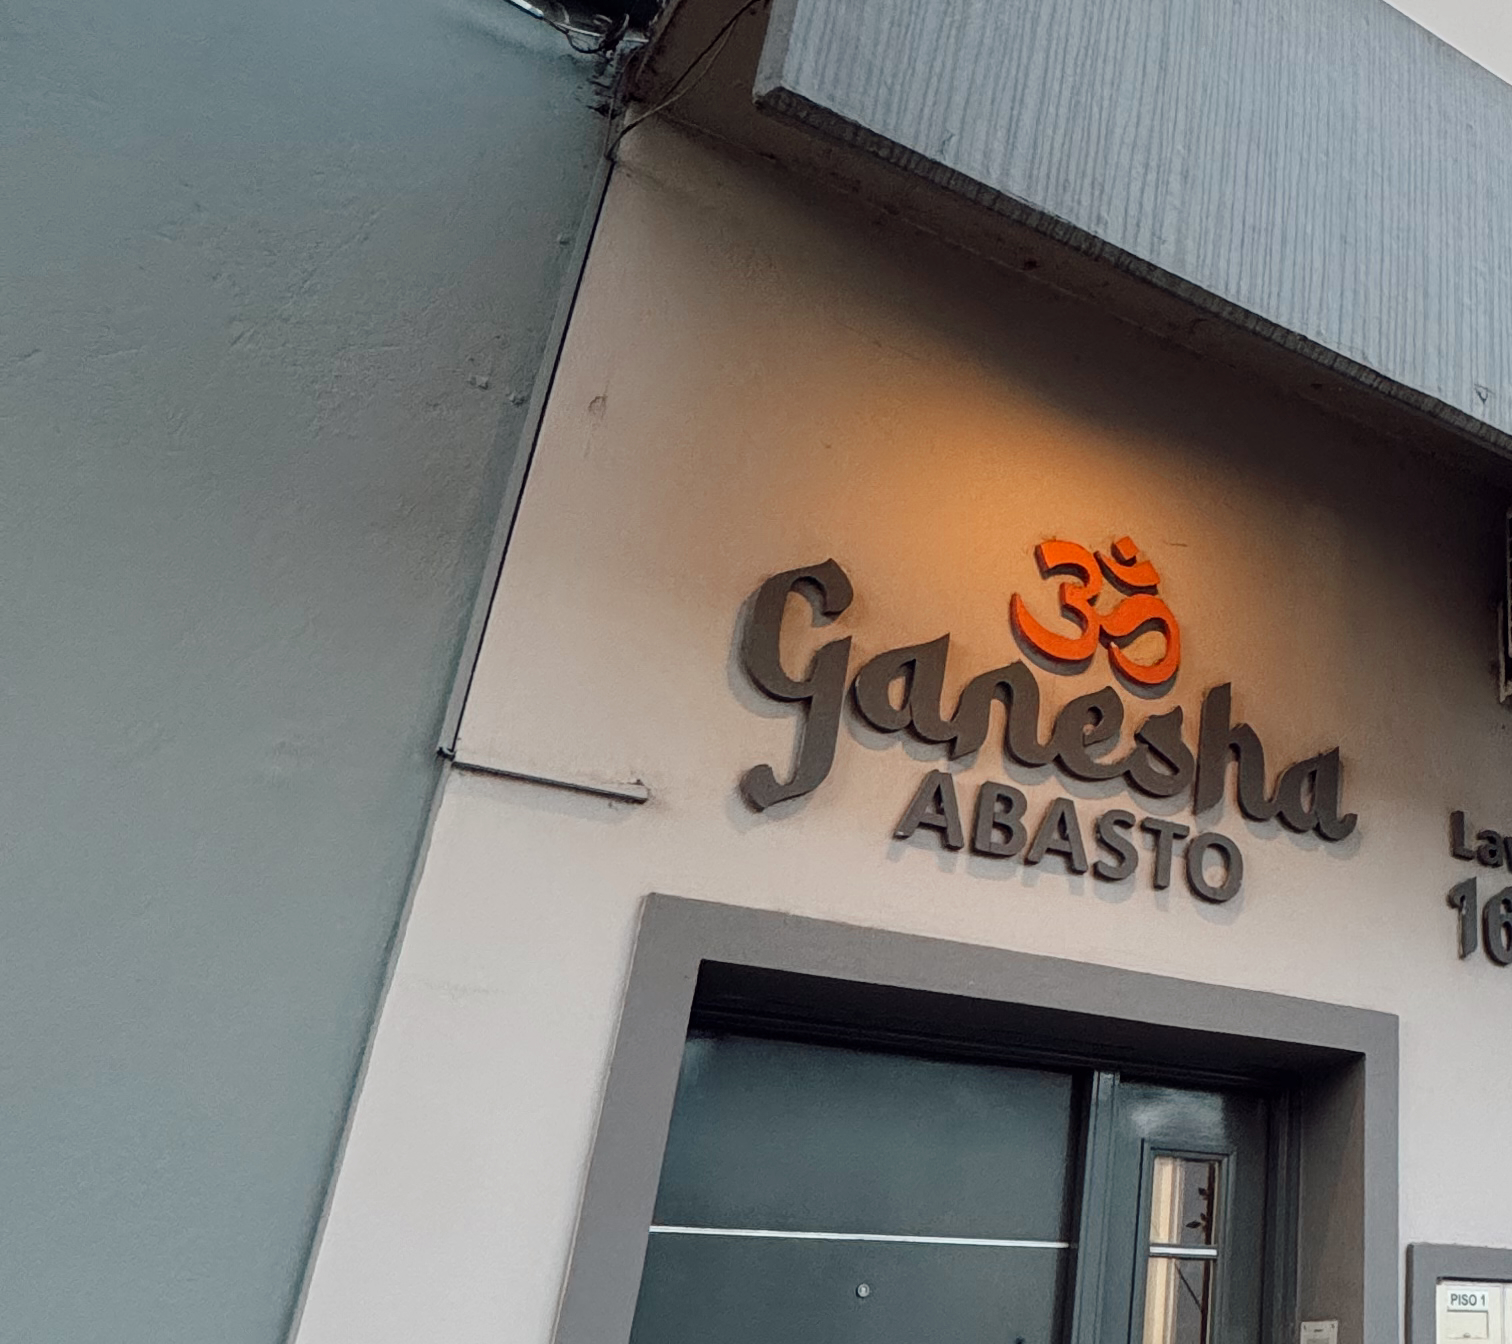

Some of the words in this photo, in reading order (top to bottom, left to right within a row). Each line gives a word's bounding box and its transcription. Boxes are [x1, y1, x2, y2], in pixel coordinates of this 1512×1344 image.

[893, 769, 1244, 904] ABASTO
[1450, 1293, 1478, 1307] PISO
[1481, 1294, 1486, 1307] 1
